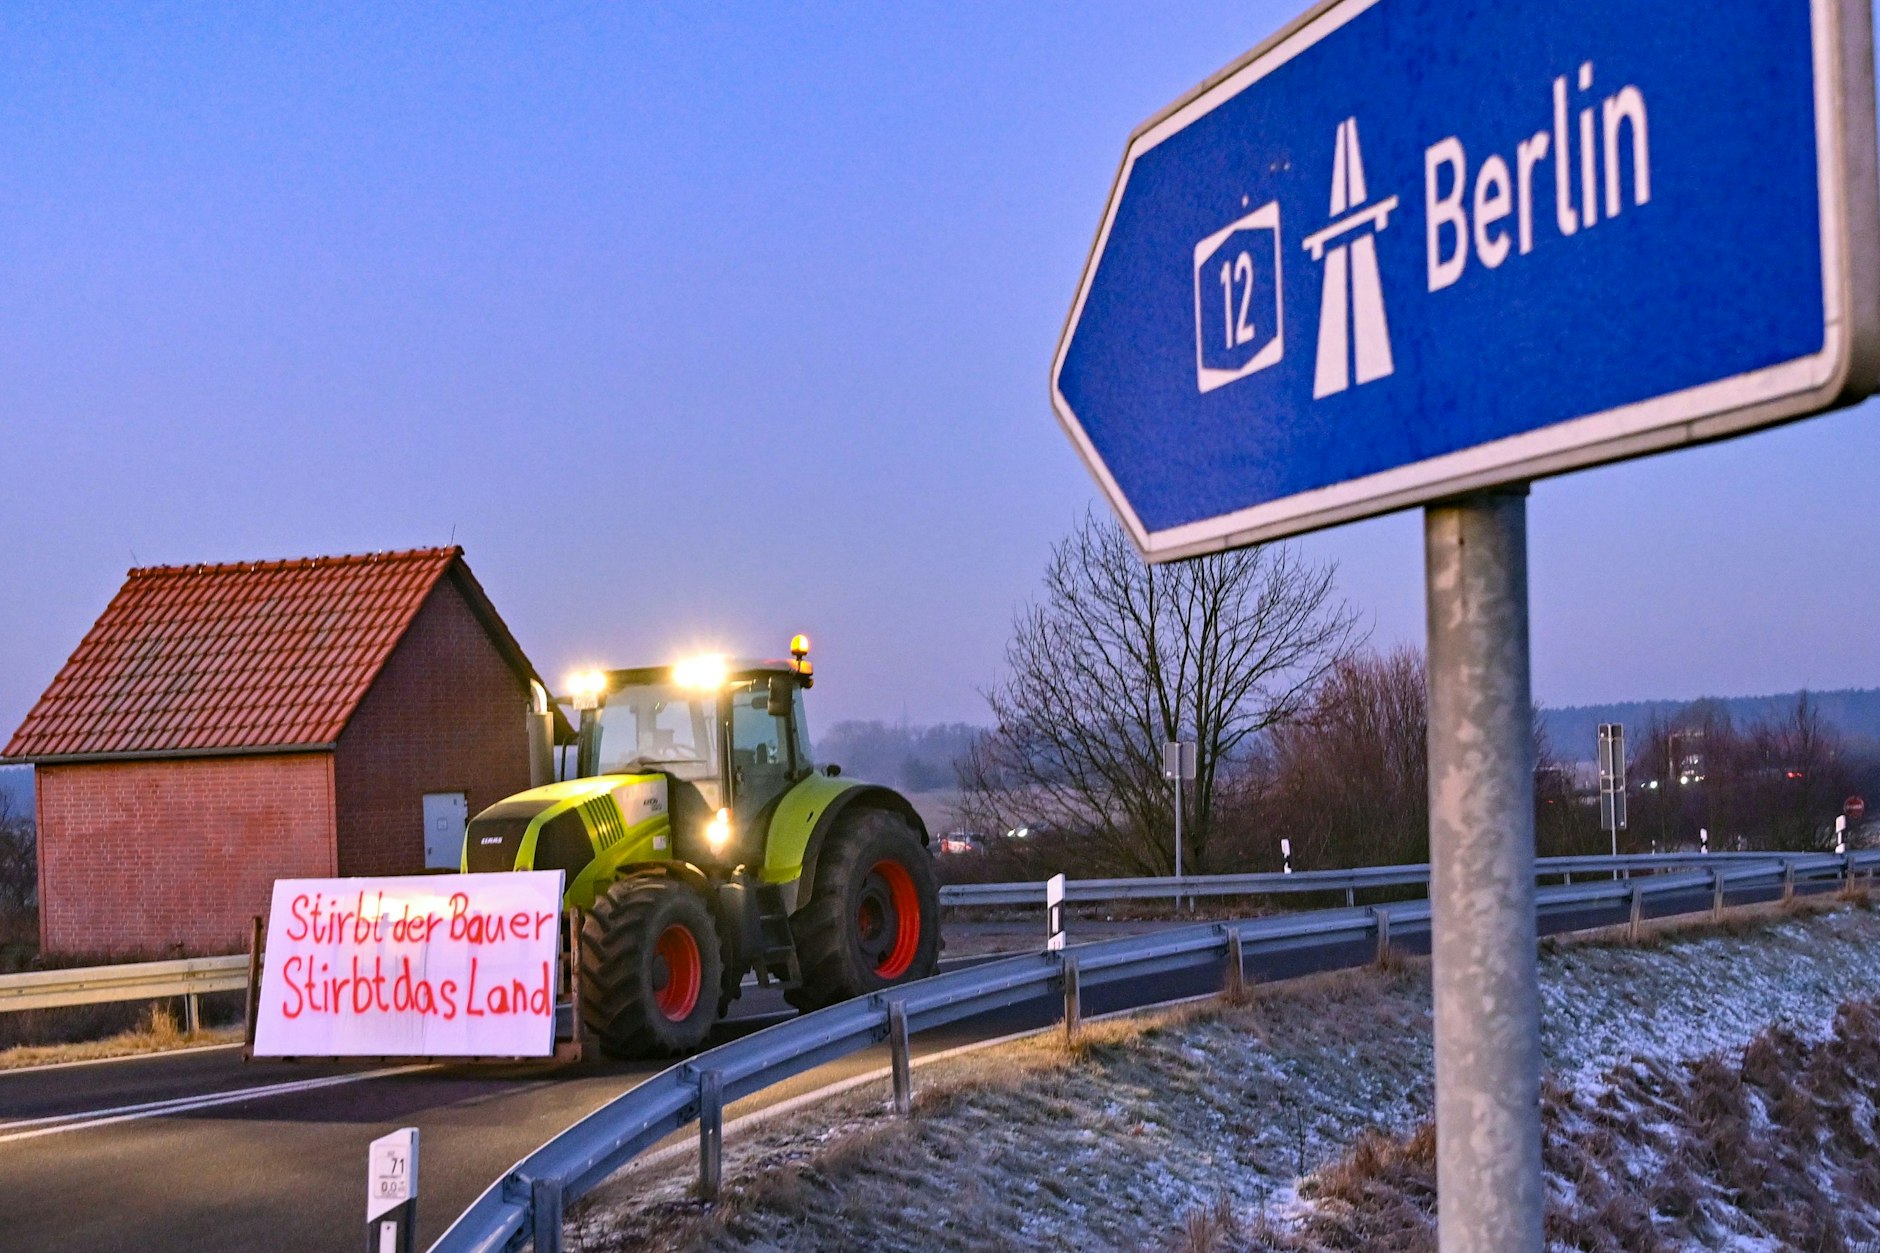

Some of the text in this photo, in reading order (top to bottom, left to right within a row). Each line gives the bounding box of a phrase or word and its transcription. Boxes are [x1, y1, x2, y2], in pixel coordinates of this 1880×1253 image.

[1425, 60, 1651, 293] Berlin
[1220, 251, 1254, 349] 12
[286, 890, 553, 945] Stirbt der Bauer
[282, 954, 551, 1020] Stirbt das Land
[391, 1158, 404, 1174] 71
